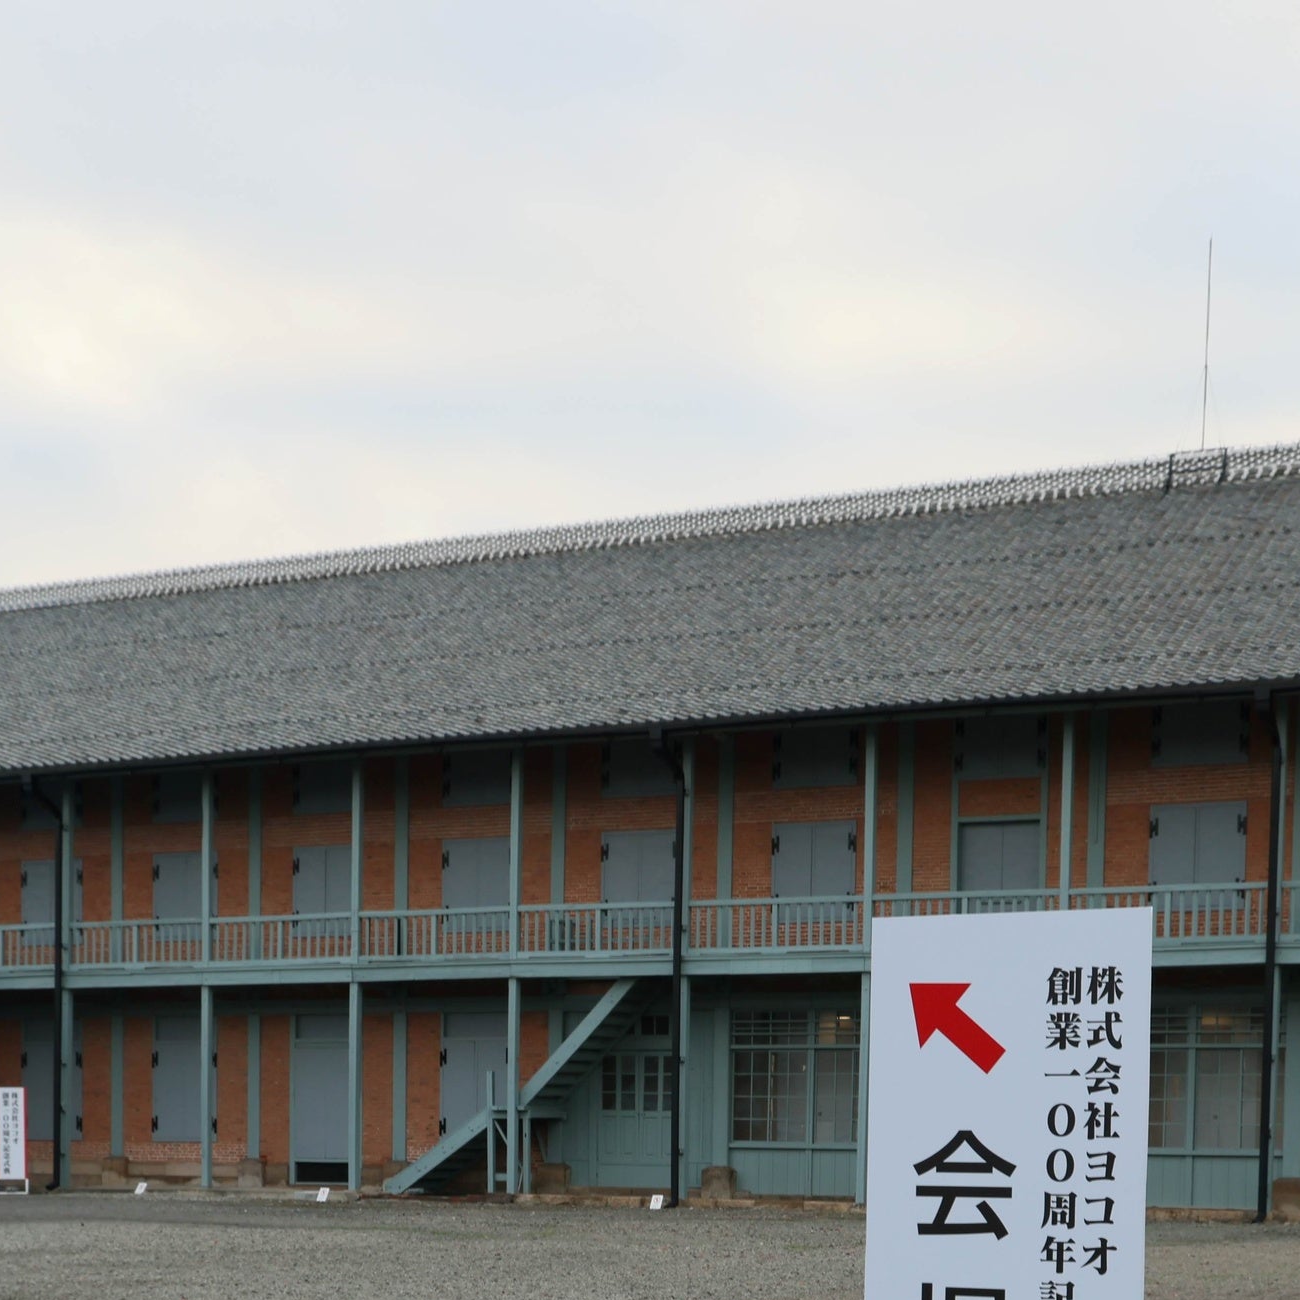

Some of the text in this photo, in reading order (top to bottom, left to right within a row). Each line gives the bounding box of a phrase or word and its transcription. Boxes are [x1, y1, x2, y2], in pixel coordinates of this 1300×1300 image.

[1081, 966, 1124, 1276] 株式会社ヨコオ
